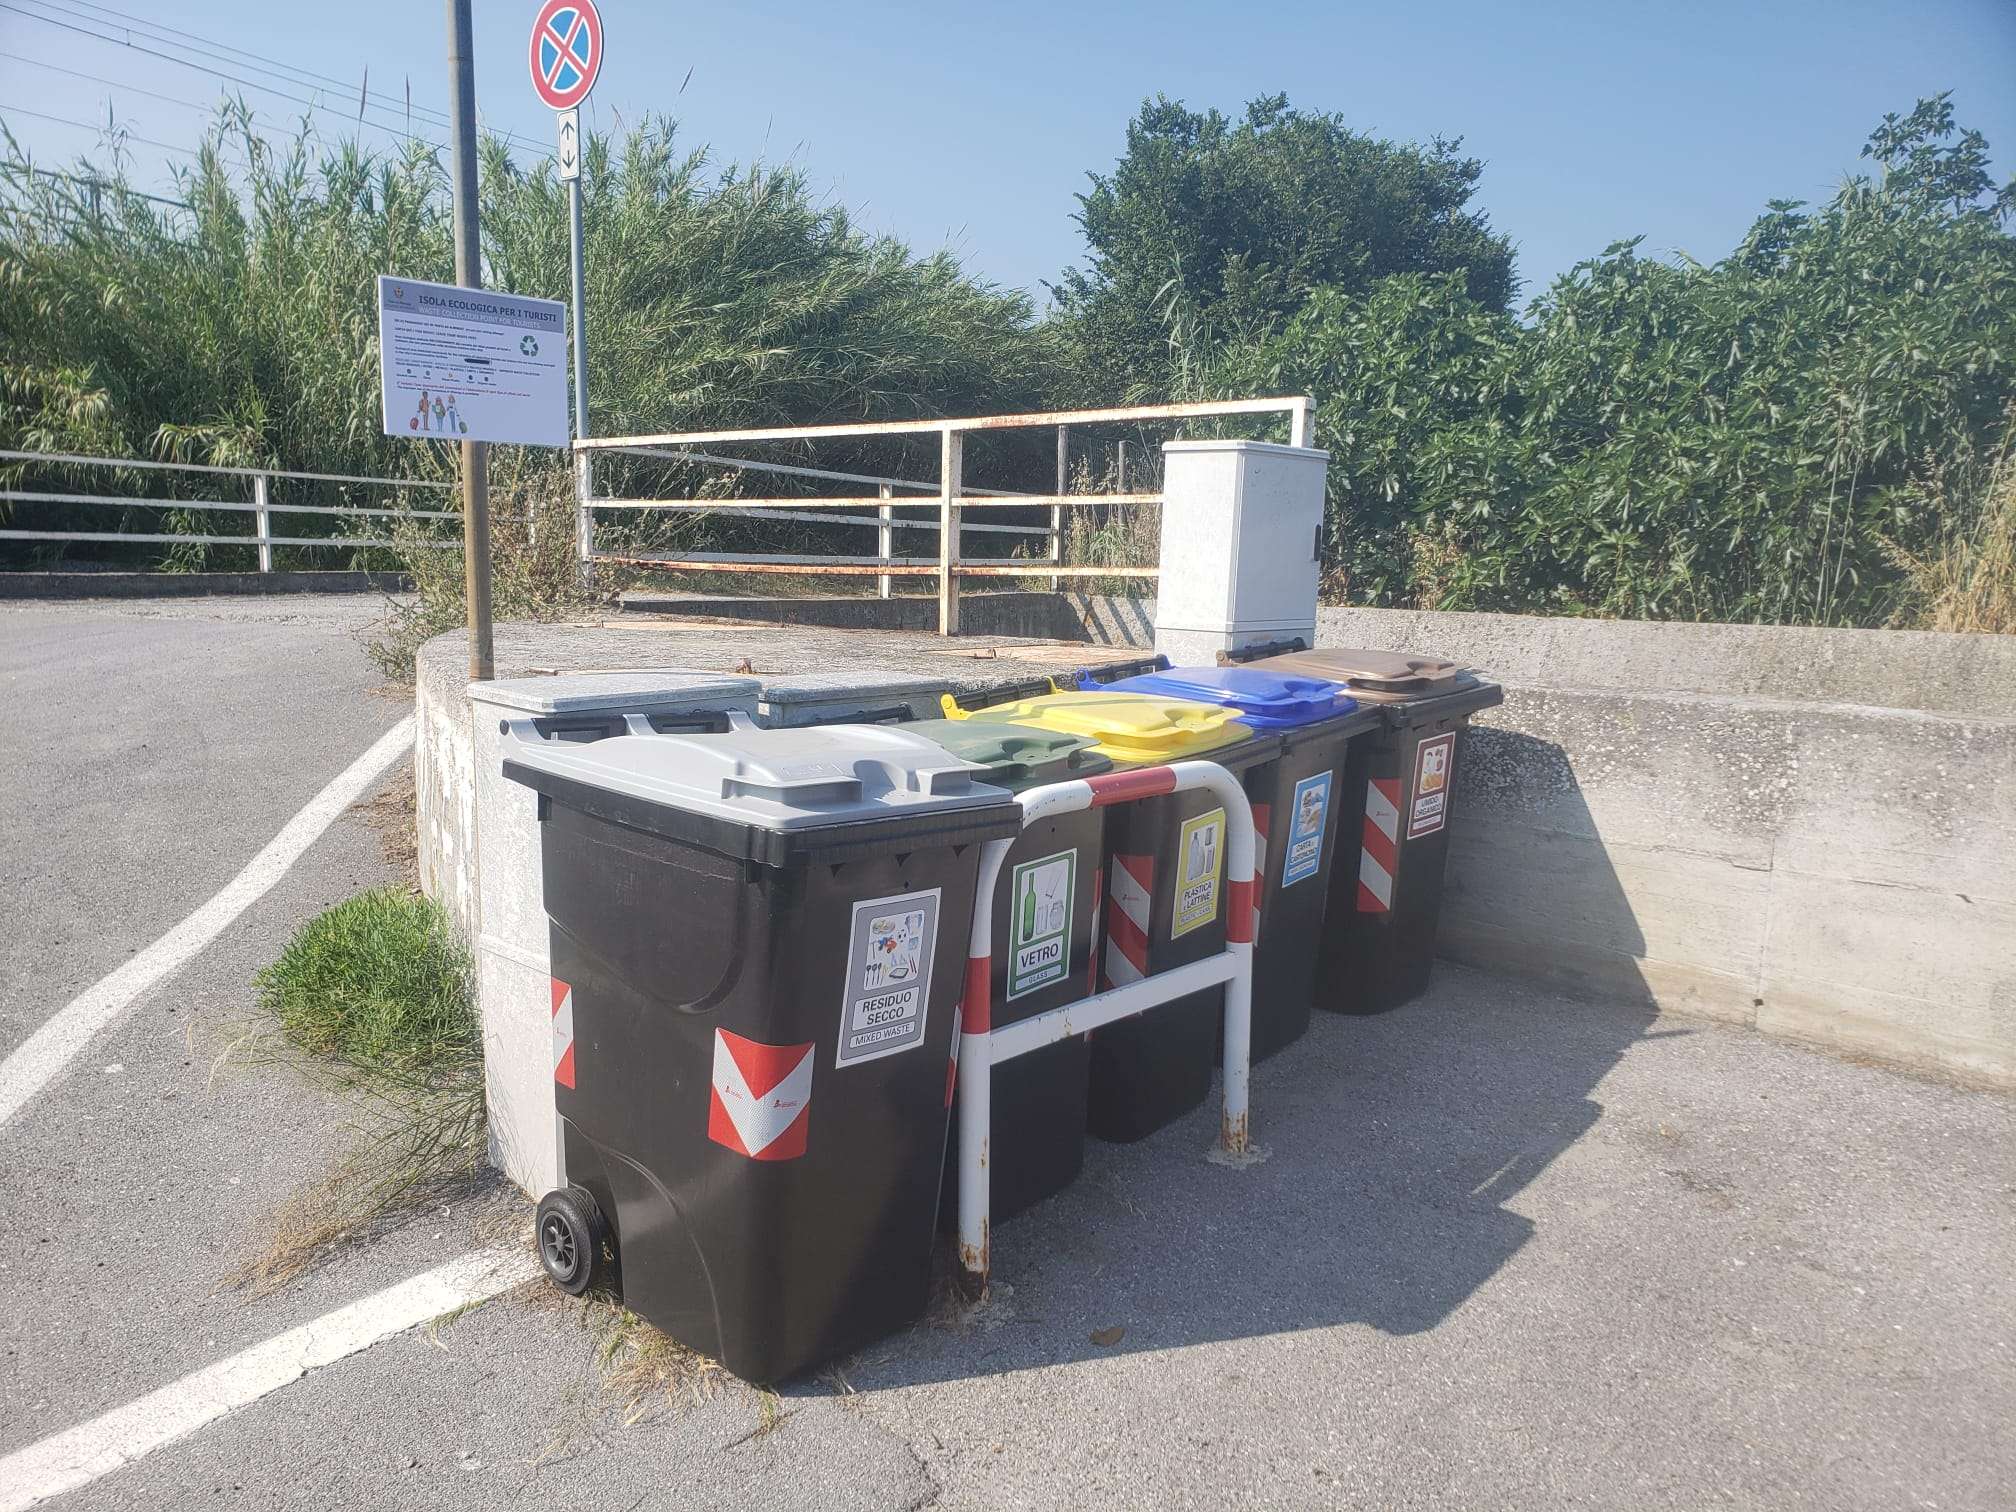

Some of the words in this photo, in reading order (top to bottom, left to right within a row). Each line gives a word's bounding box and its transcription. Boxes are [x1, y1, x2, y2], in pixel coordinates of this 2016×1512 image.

[419, 295, 447, 307] ISOLA
[448, 299, 498, 314] ECOLOGICA
[500, 306, 516, 318] PER
[517, 308, 522, 317] I
[524, 310, 557, 322] TURISTI
[1184, 881, 1212, 900] PLASTICA
[1186, 892, 1211, 909] LATTINE
[1021, 943, 1059, 968] VETRO
[1028, 971, 1048, 984] GLASS
[862, 991, 912, 1013] RESIDUO
[867, 1006, 904, 1025] SECCO
[855, 1029, 882, 1045] MIXED
[883, 1022, 911, 1039] WASTE
